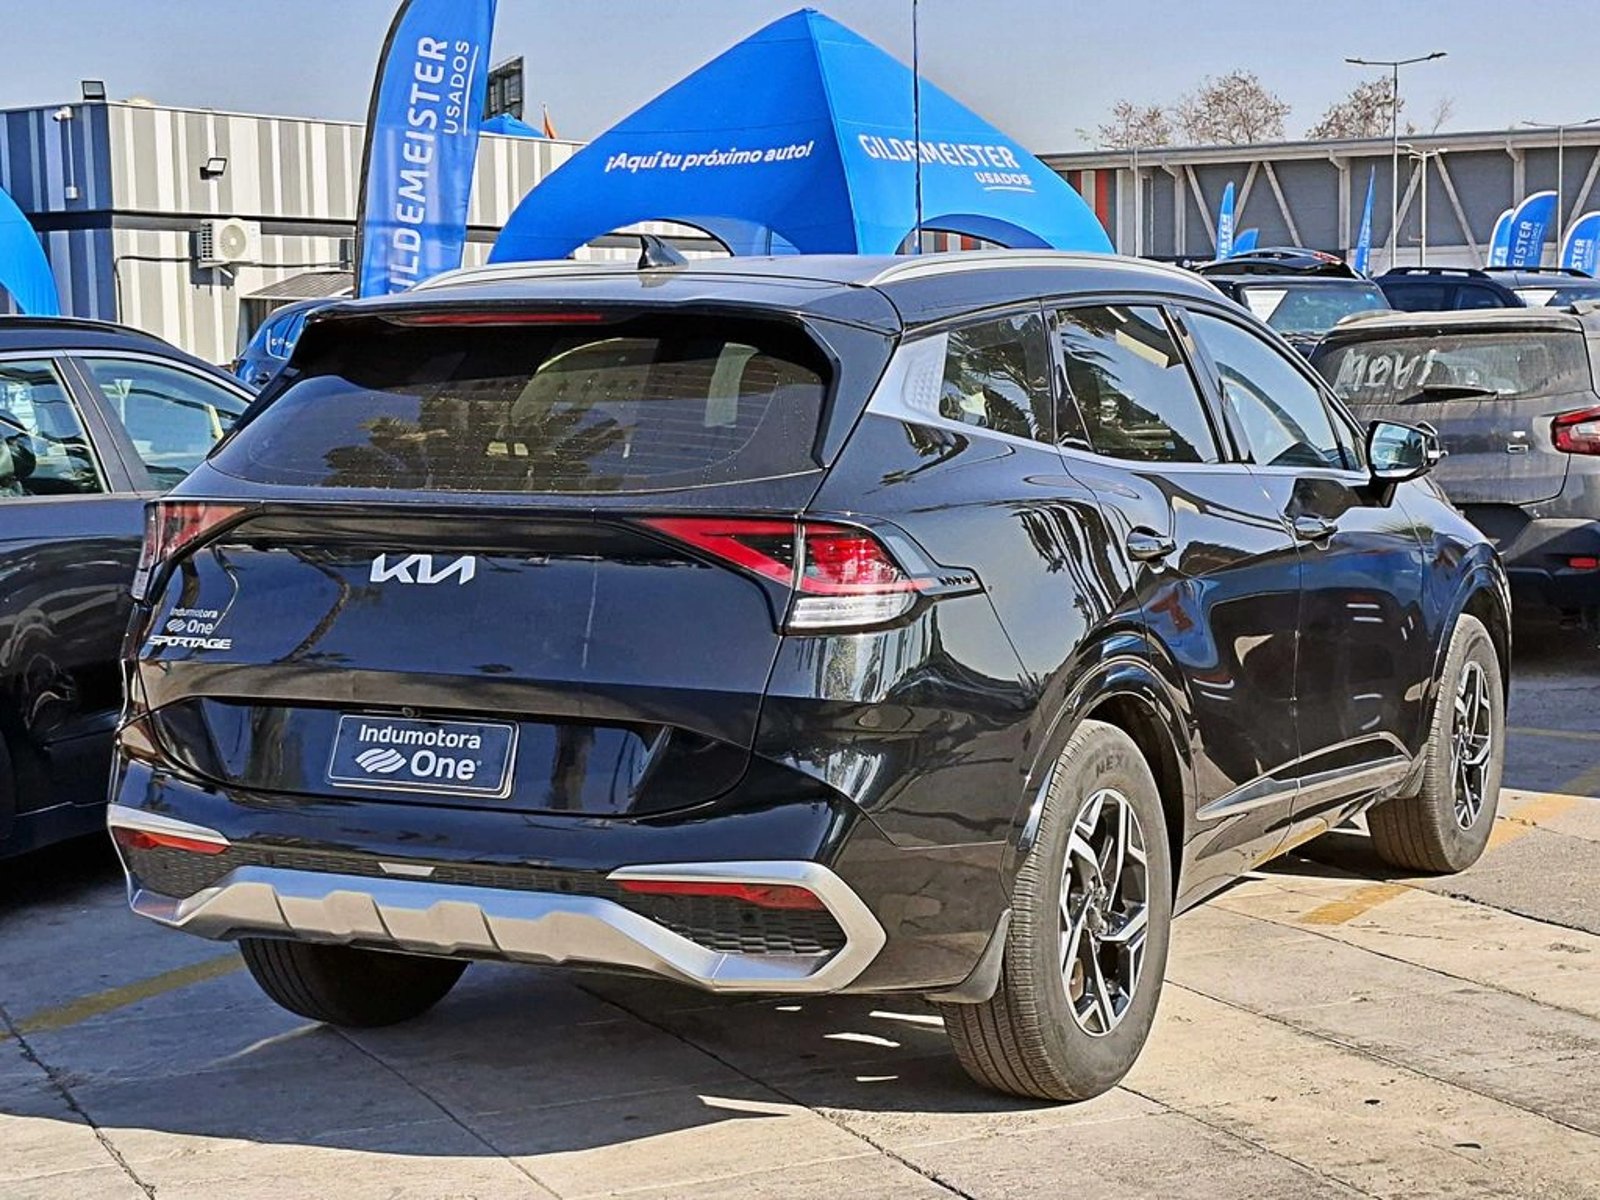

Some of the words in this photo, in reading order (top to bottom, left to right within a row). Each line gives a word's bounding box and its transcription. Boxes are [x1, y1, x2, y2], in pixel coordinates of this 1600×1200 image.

[443, 41, 470, 134] USADOS
[386, 36, 448, 294] ILDEMEISTER
[605, 151, 661, 173] ¡Aquí
[660, 152, 681, 169] tu
[681, 147, 762, 171] próximo
[764, 141, 814, 162] auto!
[858, 134, 1020, 169] GILDEMEISTER
[974, 172, 1032, 186] USADOS
[370, 553, 476, 585] KIA
[170, 607, 218, 618] Indumotora
[187, 620, 213, 634] One
[149, 635, 232, 649] SPORTAGE
[359, 724, 481, 749] Indumotora
[410, 750, 476, 781] One
